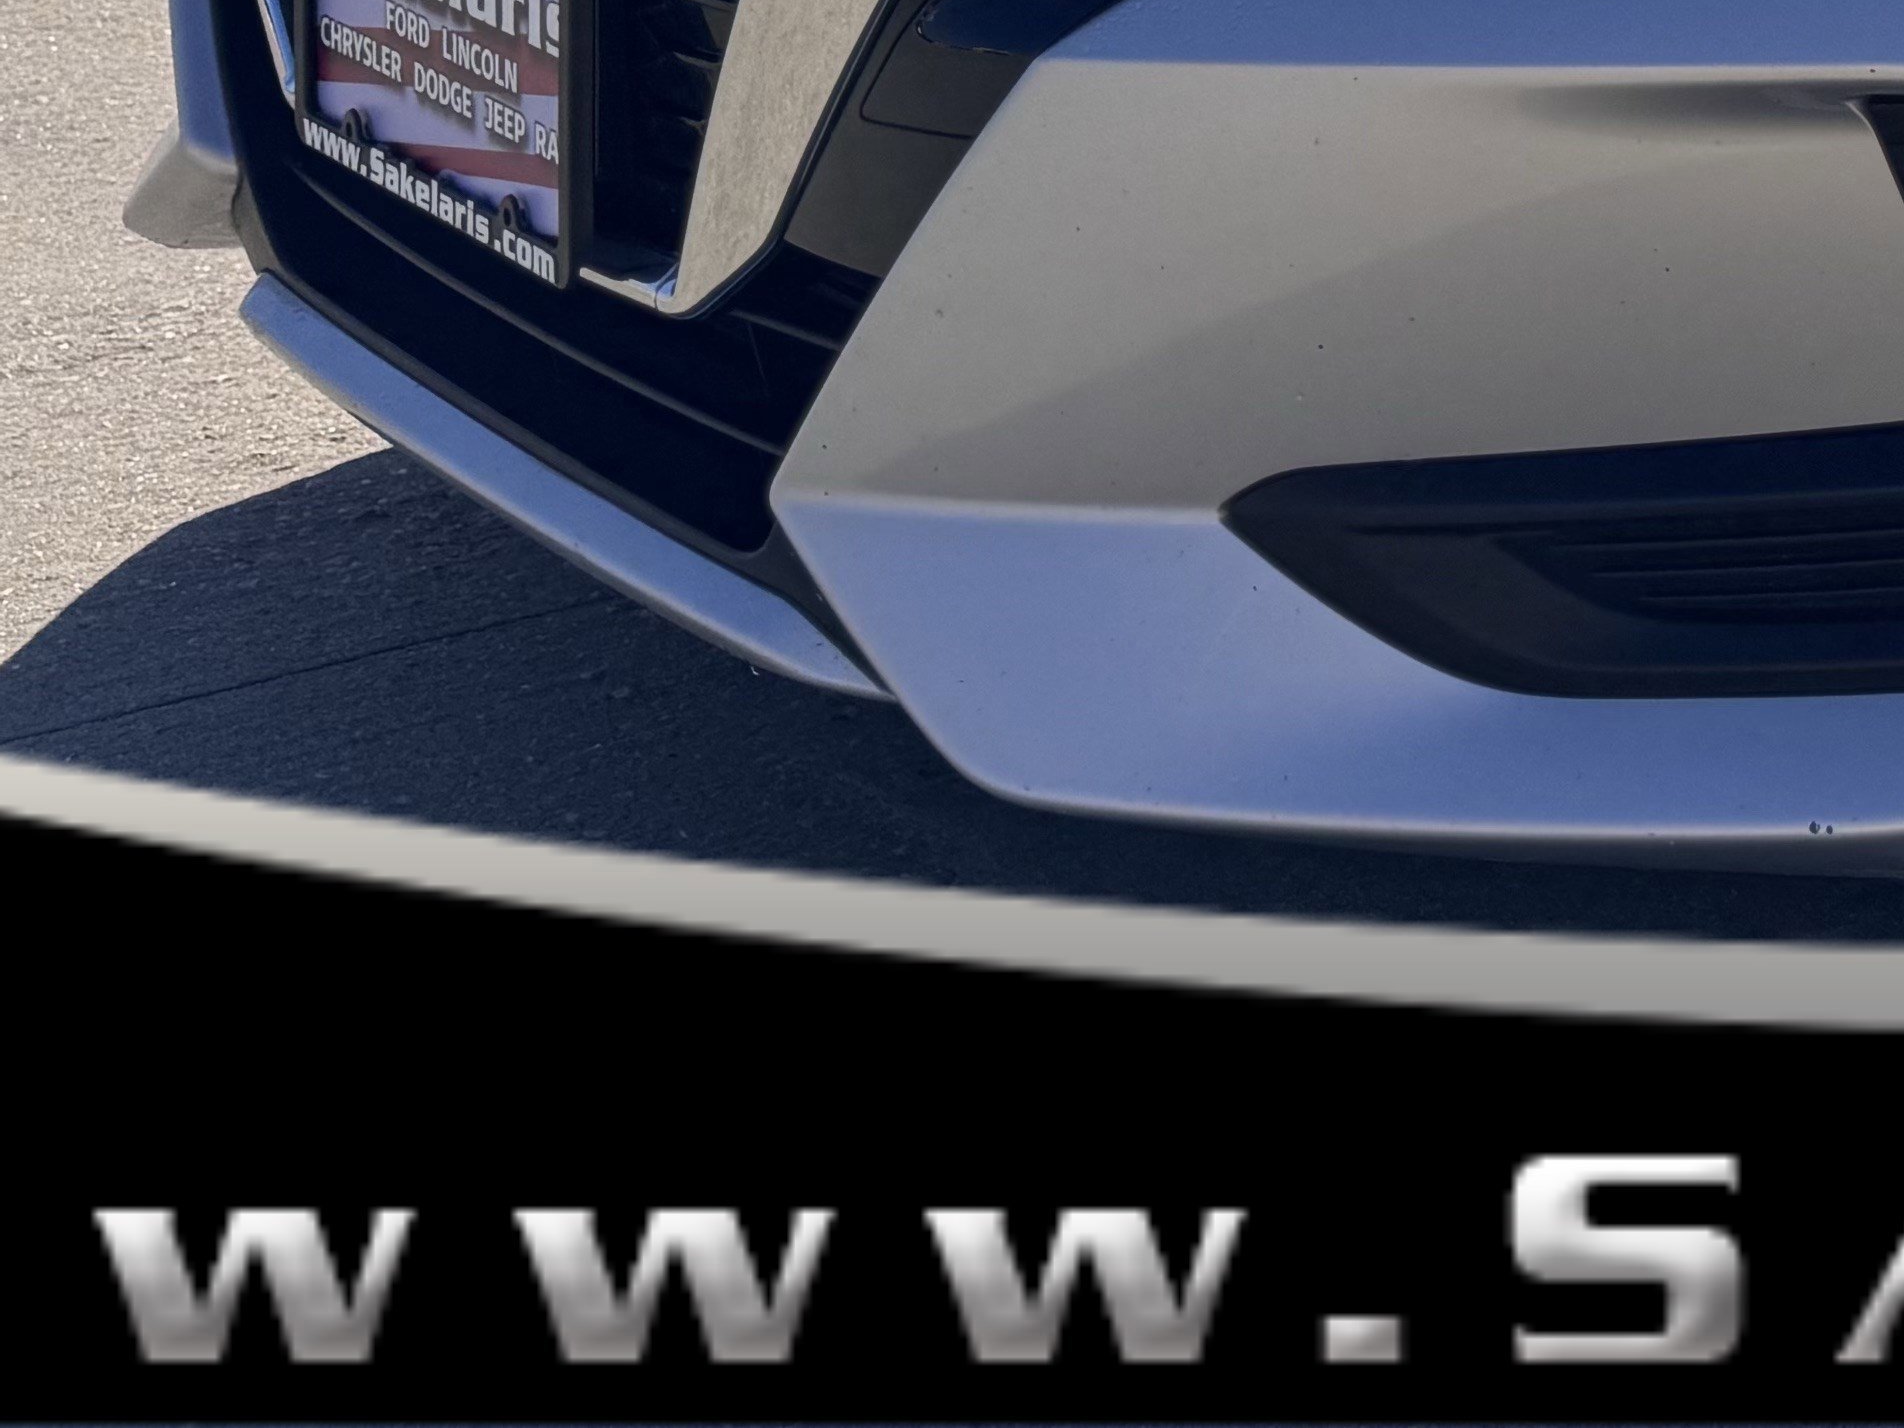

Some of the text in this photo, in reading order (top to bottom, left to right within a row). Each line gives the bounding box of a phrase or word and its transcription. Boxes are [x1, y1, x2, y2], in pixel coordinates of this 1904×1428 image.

[320, 16, 560, 166] CHRYSLER DODGE JEEP RA
[385, 0, 518, 94] FORD LINCOLN
